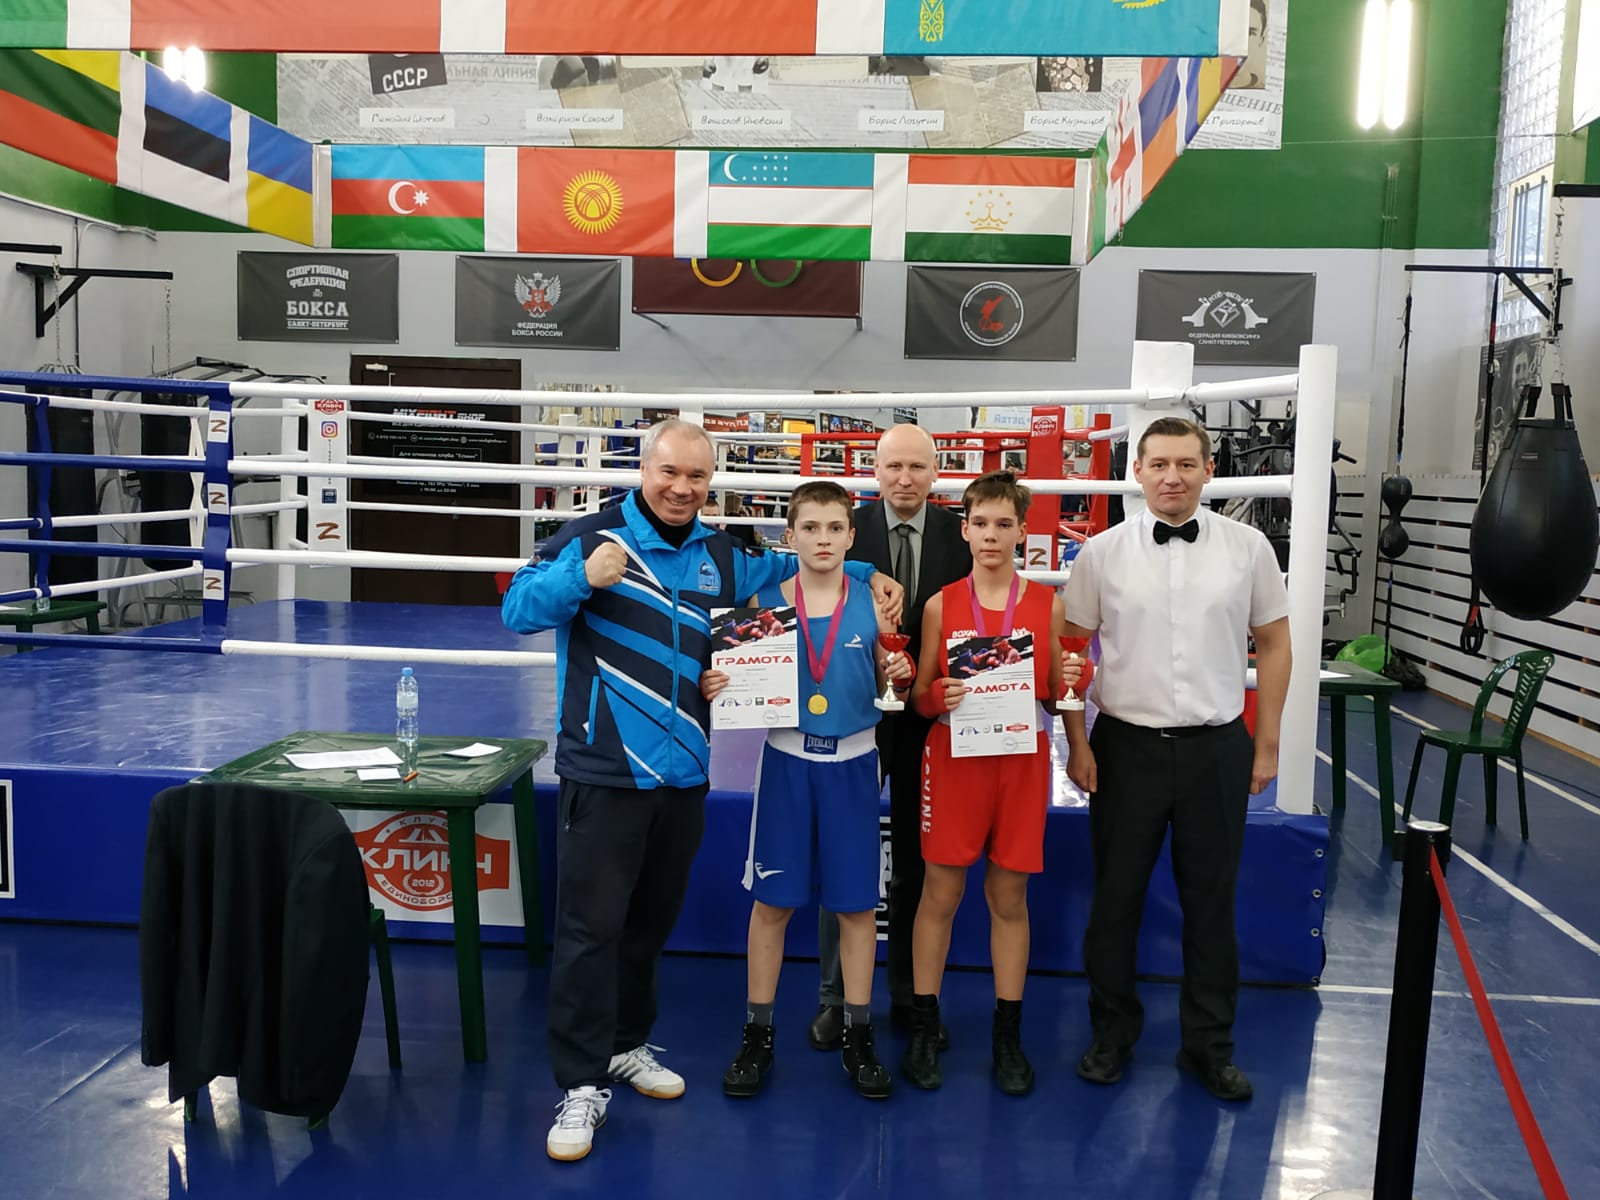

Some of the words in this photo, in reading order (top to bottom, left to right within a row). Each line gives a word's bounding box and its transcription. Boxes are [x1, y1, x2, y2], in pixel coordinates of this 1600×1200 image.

[382, 67, 428, 93] СССР
[868, 115, 897, 126] Борис
[1030, 115, 1061, 126] Борис
[286, 264, 349, 280] СПОРТИВНАЯ
[289, 276, 346, 290] ФЕДЕРАЦИЯ
[286, 300, 349, 317] БОКСА
[516, 322, 558, 330] ФЕДЕРАЦИЯ
[716, 655, 794, 666] ГРАМОТА
[963, 682, 1032, 695] РАМОТА
[411, 878, 436, 888] 2012
[380, 879, 453, 905] ЕДИНОБОРС
